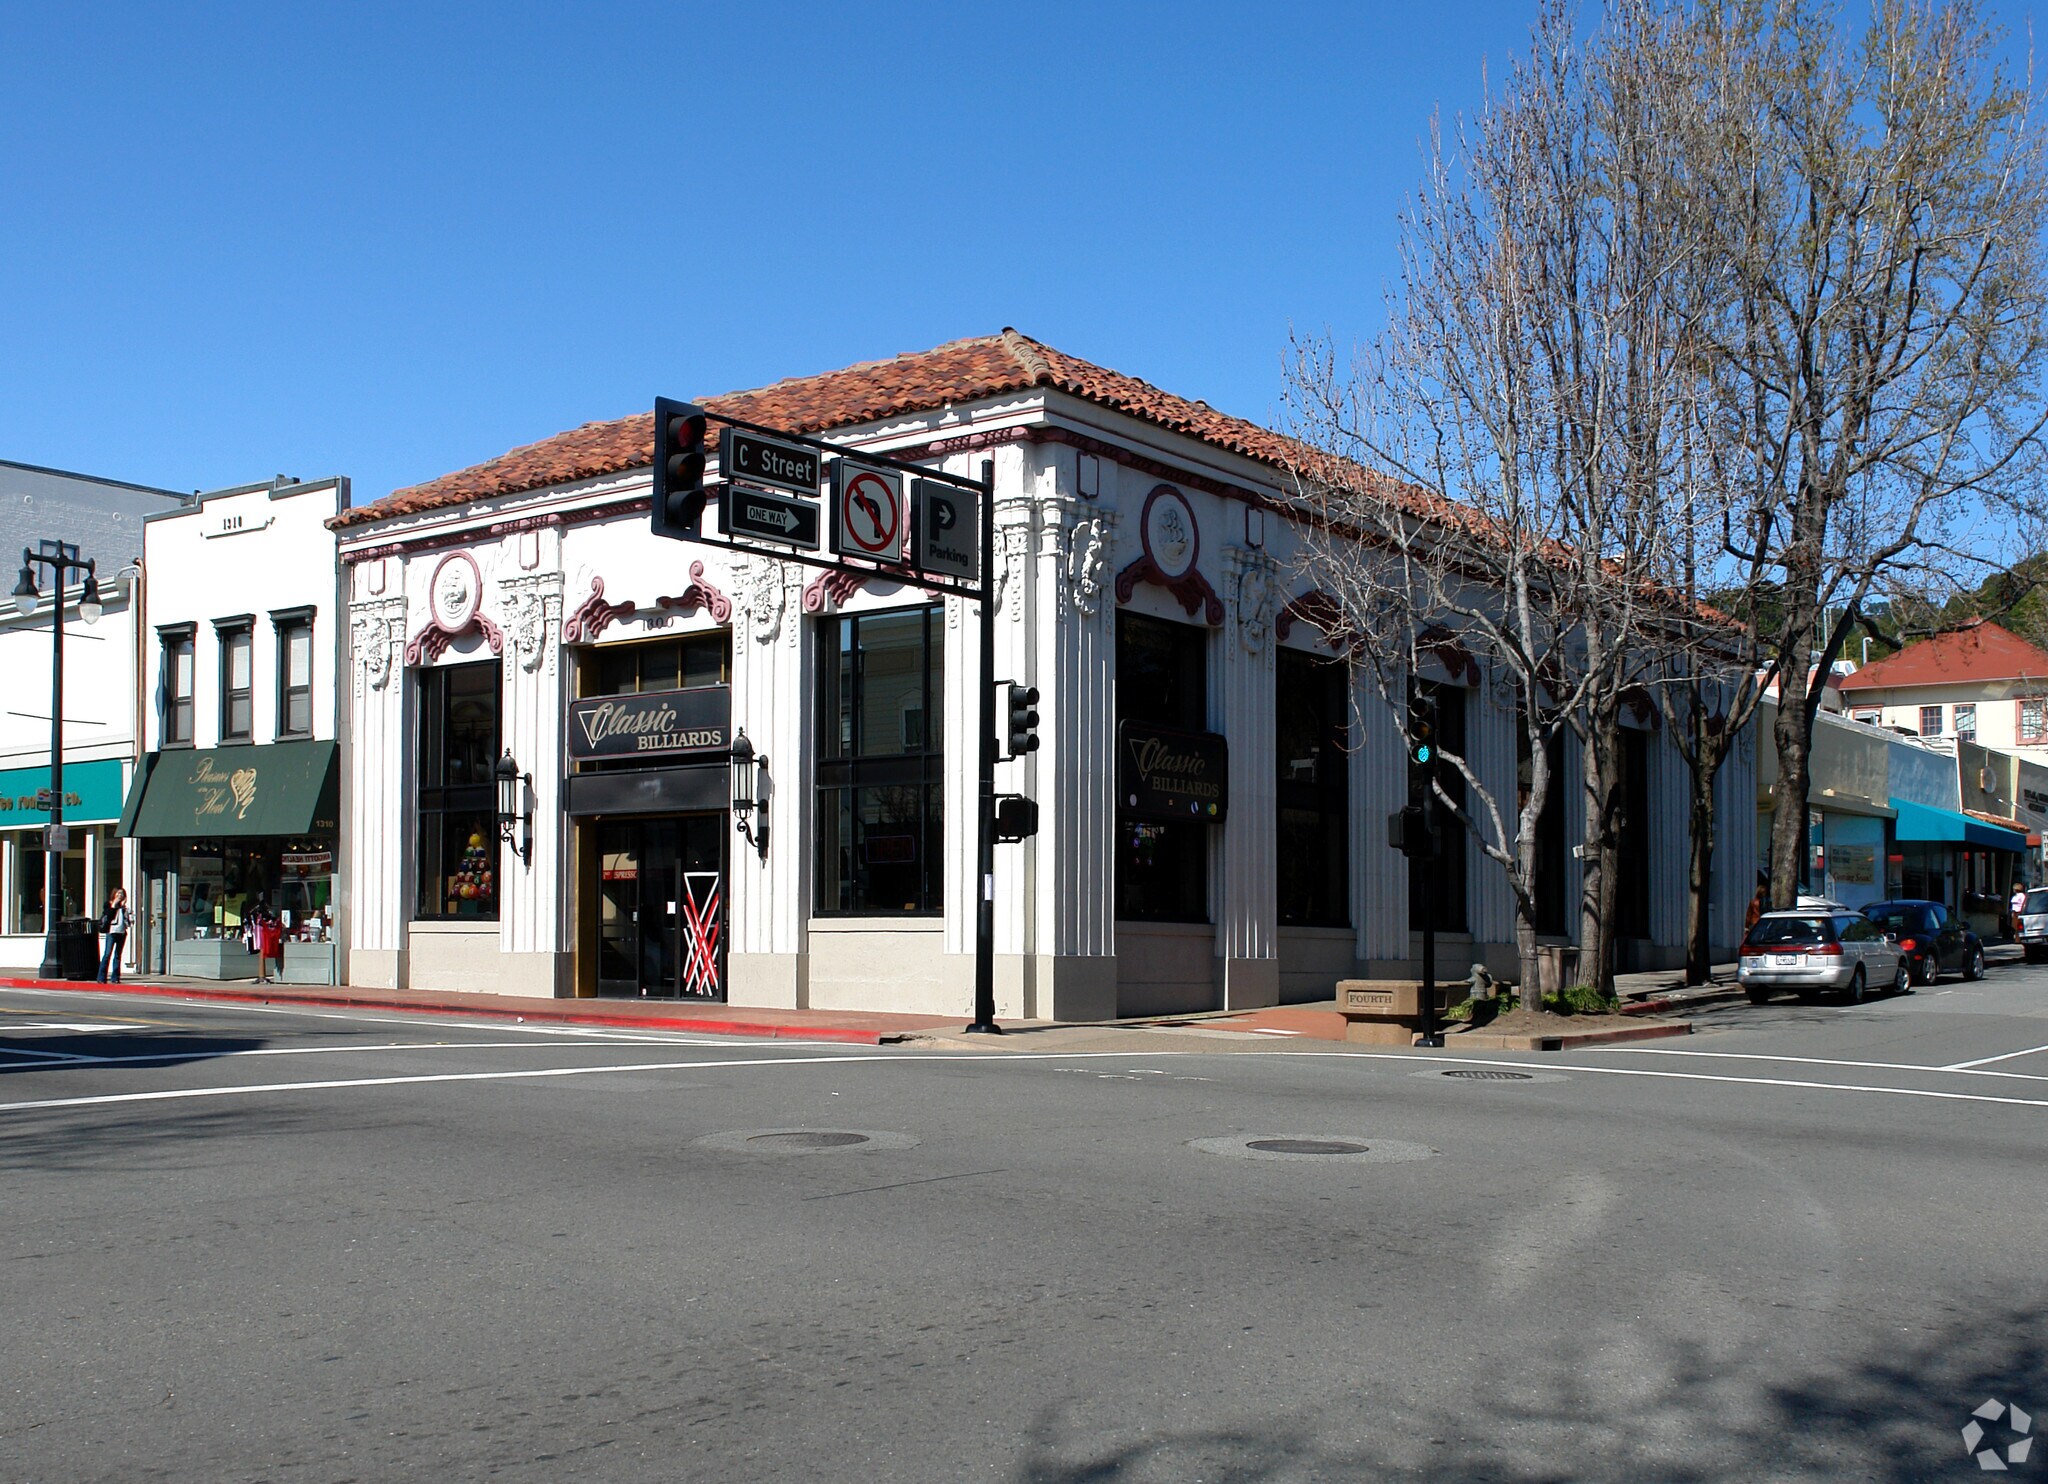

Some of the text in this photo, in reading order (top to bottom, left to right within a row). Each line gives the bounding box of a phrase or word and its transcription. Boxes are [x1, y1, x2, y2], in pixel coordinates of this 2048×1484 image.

[739, 444, 811, 482] C Street
[223, 515, 242, 530] 1310
[749, 506, 787, 525] ONE WAY
[929, 543, 968, 566] Parking
[643, 616, 674, 631] 1300
[590, 702, 677, 741] Classic
[637, 730, 722, 750] BILLIARDS
[1139, 737, 1206, 776] Classic
[1152, 776, 1220, 798] BILLIARDS
[316, 820, 334, 828] 1310
[1349, 994, 1393, 1004] FOURTH
